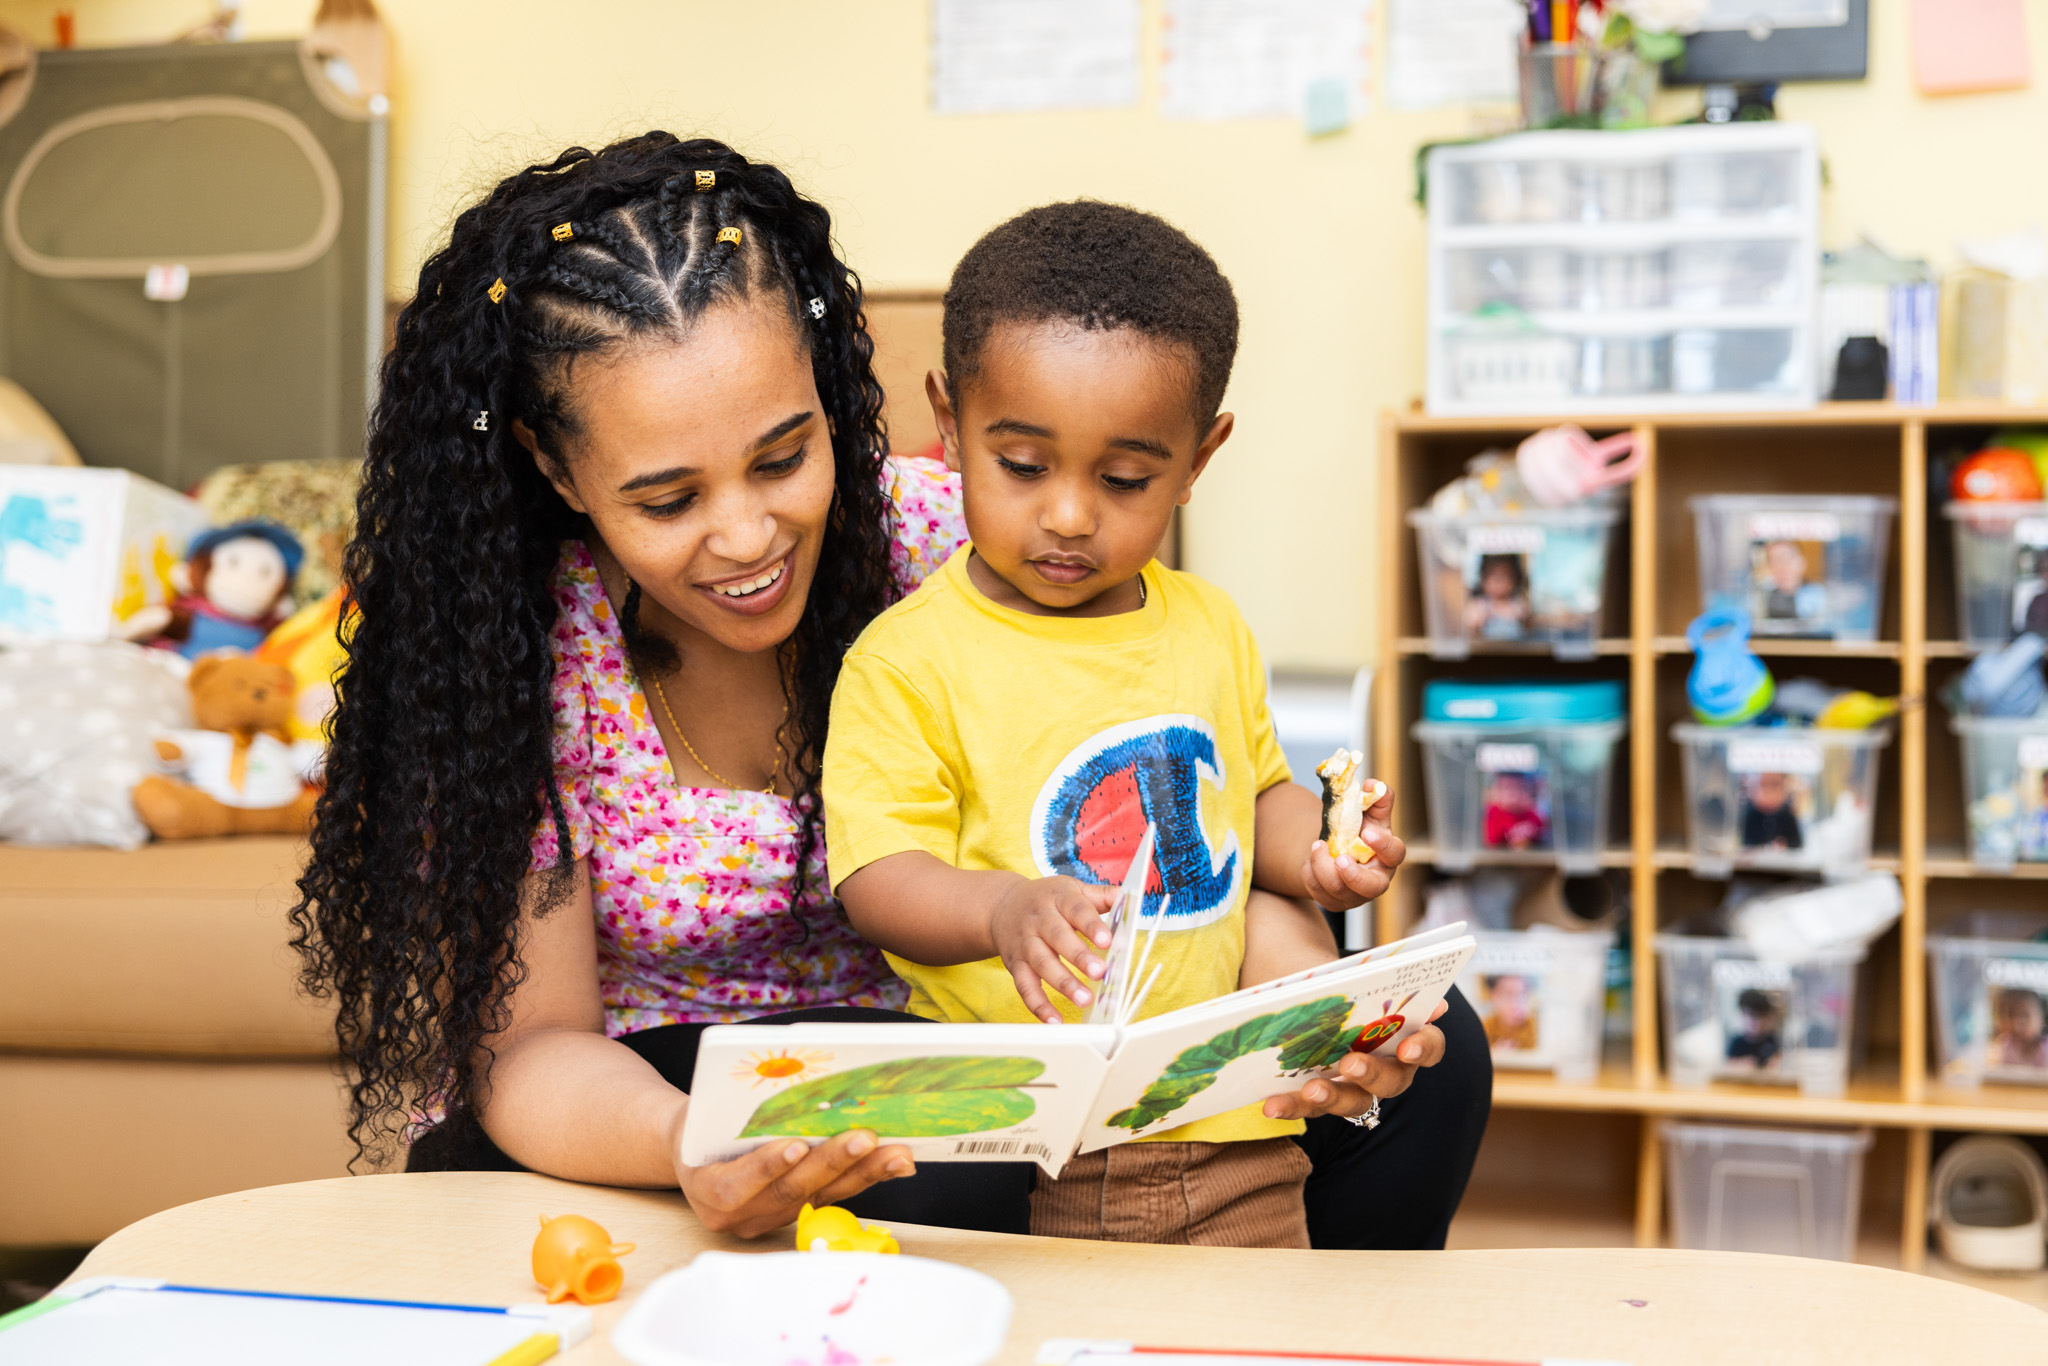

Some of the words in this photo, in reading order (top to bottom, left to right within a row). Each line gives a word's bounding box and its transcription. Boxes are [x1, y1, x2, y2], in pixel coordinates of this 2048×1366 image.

[1396, 962, 1423, 974] THE
[1426, 950, 1463, 963] VERY
[1396, 960, 1456, 980] HUNGRY
[1353, 967, 1453, 1000] CATERPILLAR
